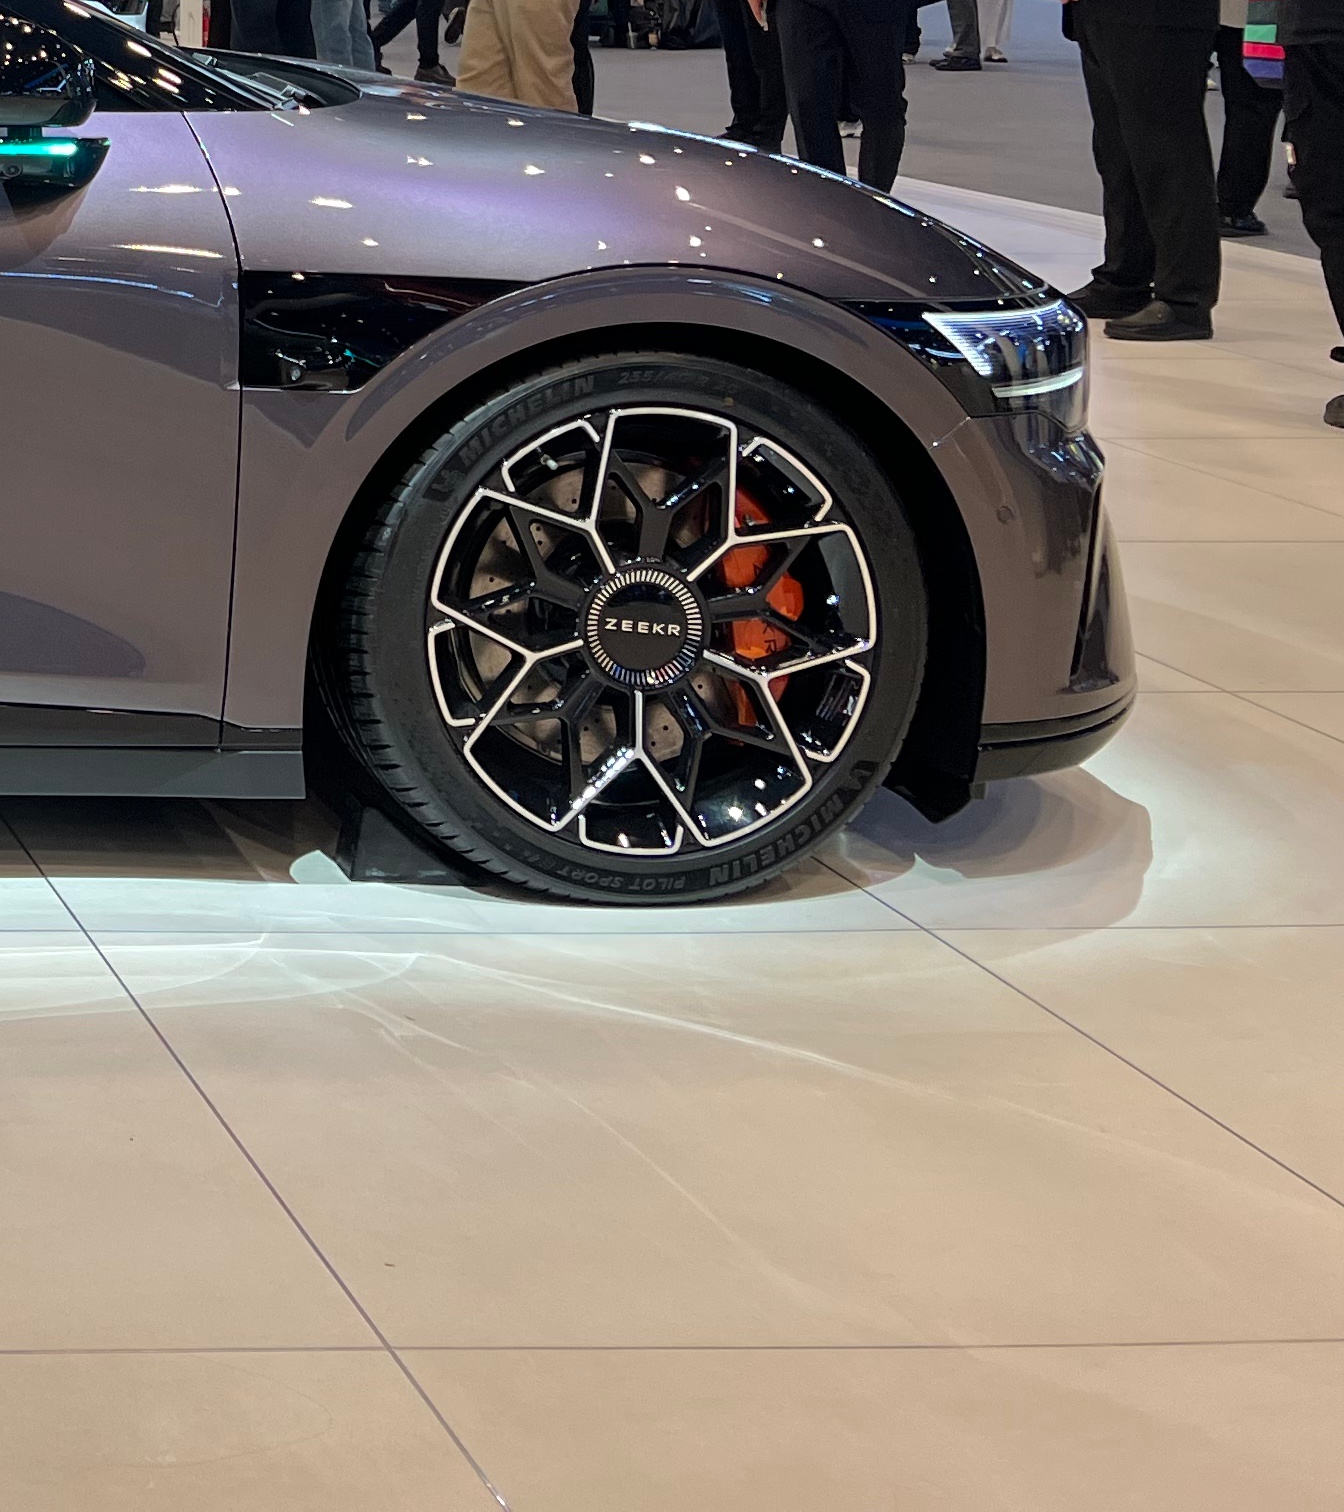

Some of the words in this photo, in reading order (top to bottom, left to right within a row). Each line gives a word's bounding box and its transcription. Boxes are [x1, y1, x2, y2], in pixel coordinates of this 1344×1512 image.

[459, 375, 595, 465] MICHELIN
[604, 617, 681, 637] ZEEKR
[708, 793, 845, 886] MICHELIN
[555, 864, 625, 888] SPORT
[628, 875, 687, 891] PILOT
